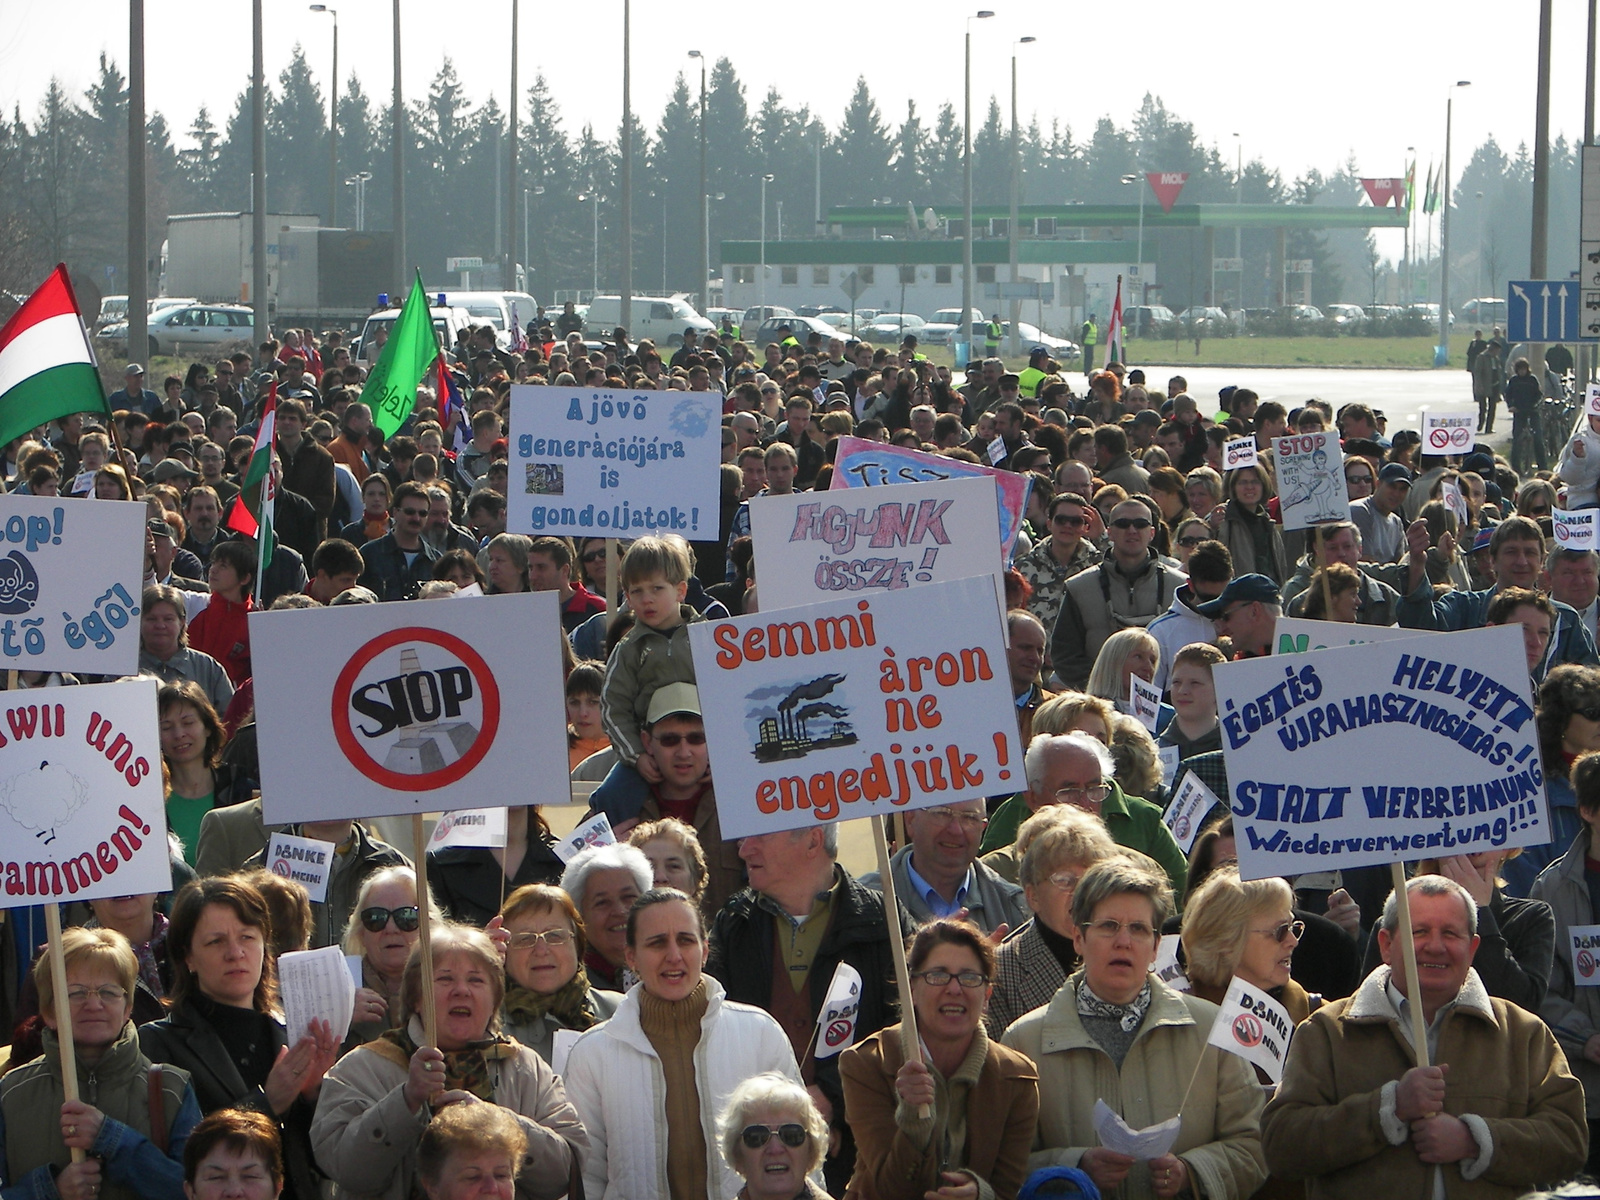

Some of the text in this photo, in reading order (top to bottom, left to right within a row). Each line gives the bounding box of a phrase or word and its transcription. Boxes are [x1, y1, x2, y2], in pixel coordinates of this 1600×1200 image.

[1161, 173, 1184, 185] MOL
[566, 397, 584, 421] A
[1278, 435, 1327, 456] STOP
[600, 465, 620, 489] is
[1281, 467, 1299, 475] WITH
[0, 507, 65, 551] op!
[713, 600, 877, 670] Semmi
[351, 665, 474, 738] STOP
[885, 694, 943, 733] ne
[1392, 653, 1535, 733] HELYETT
[86, 711, 150, 787] uns
[1232, 758, 1544, 824] STATT VERBRENNUNG
[0, 804, 151, 895] ammen!
